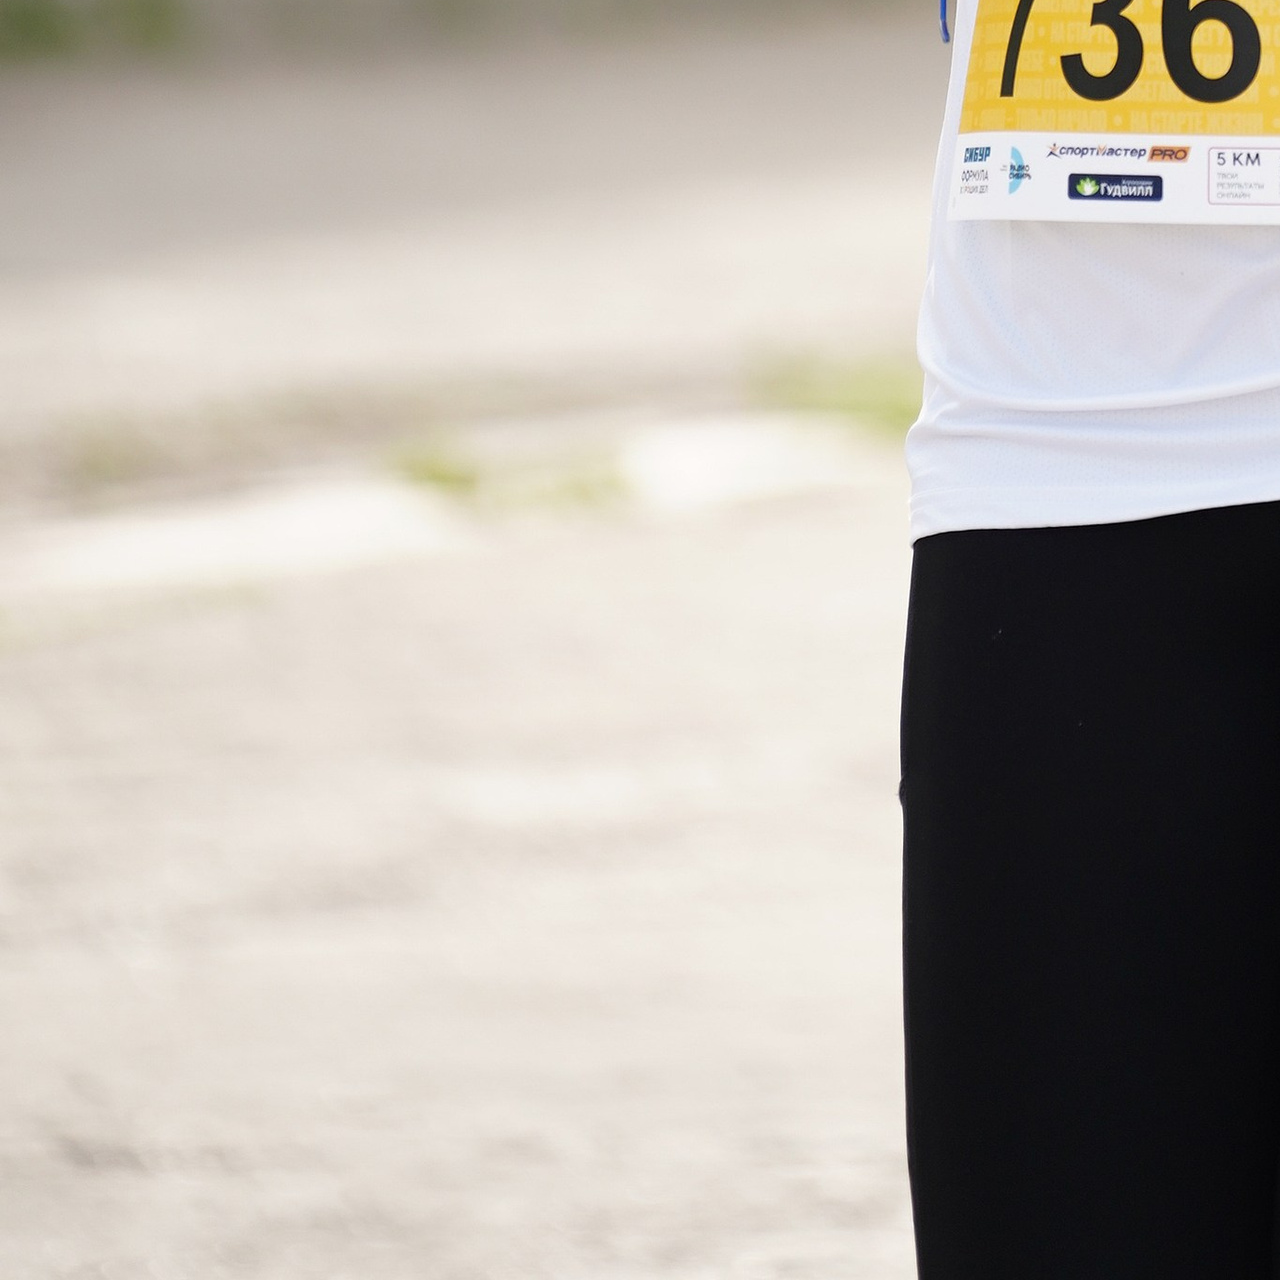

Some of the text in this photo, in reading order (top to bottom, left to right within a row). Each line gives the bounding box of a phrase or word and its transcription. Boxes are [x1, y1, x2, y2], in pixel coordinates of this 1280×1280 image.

[963, 146, 991, 164] СИБУР
[1150, 149, 1188, 161] PRO
[1217, 152, 1226, 166] 5
